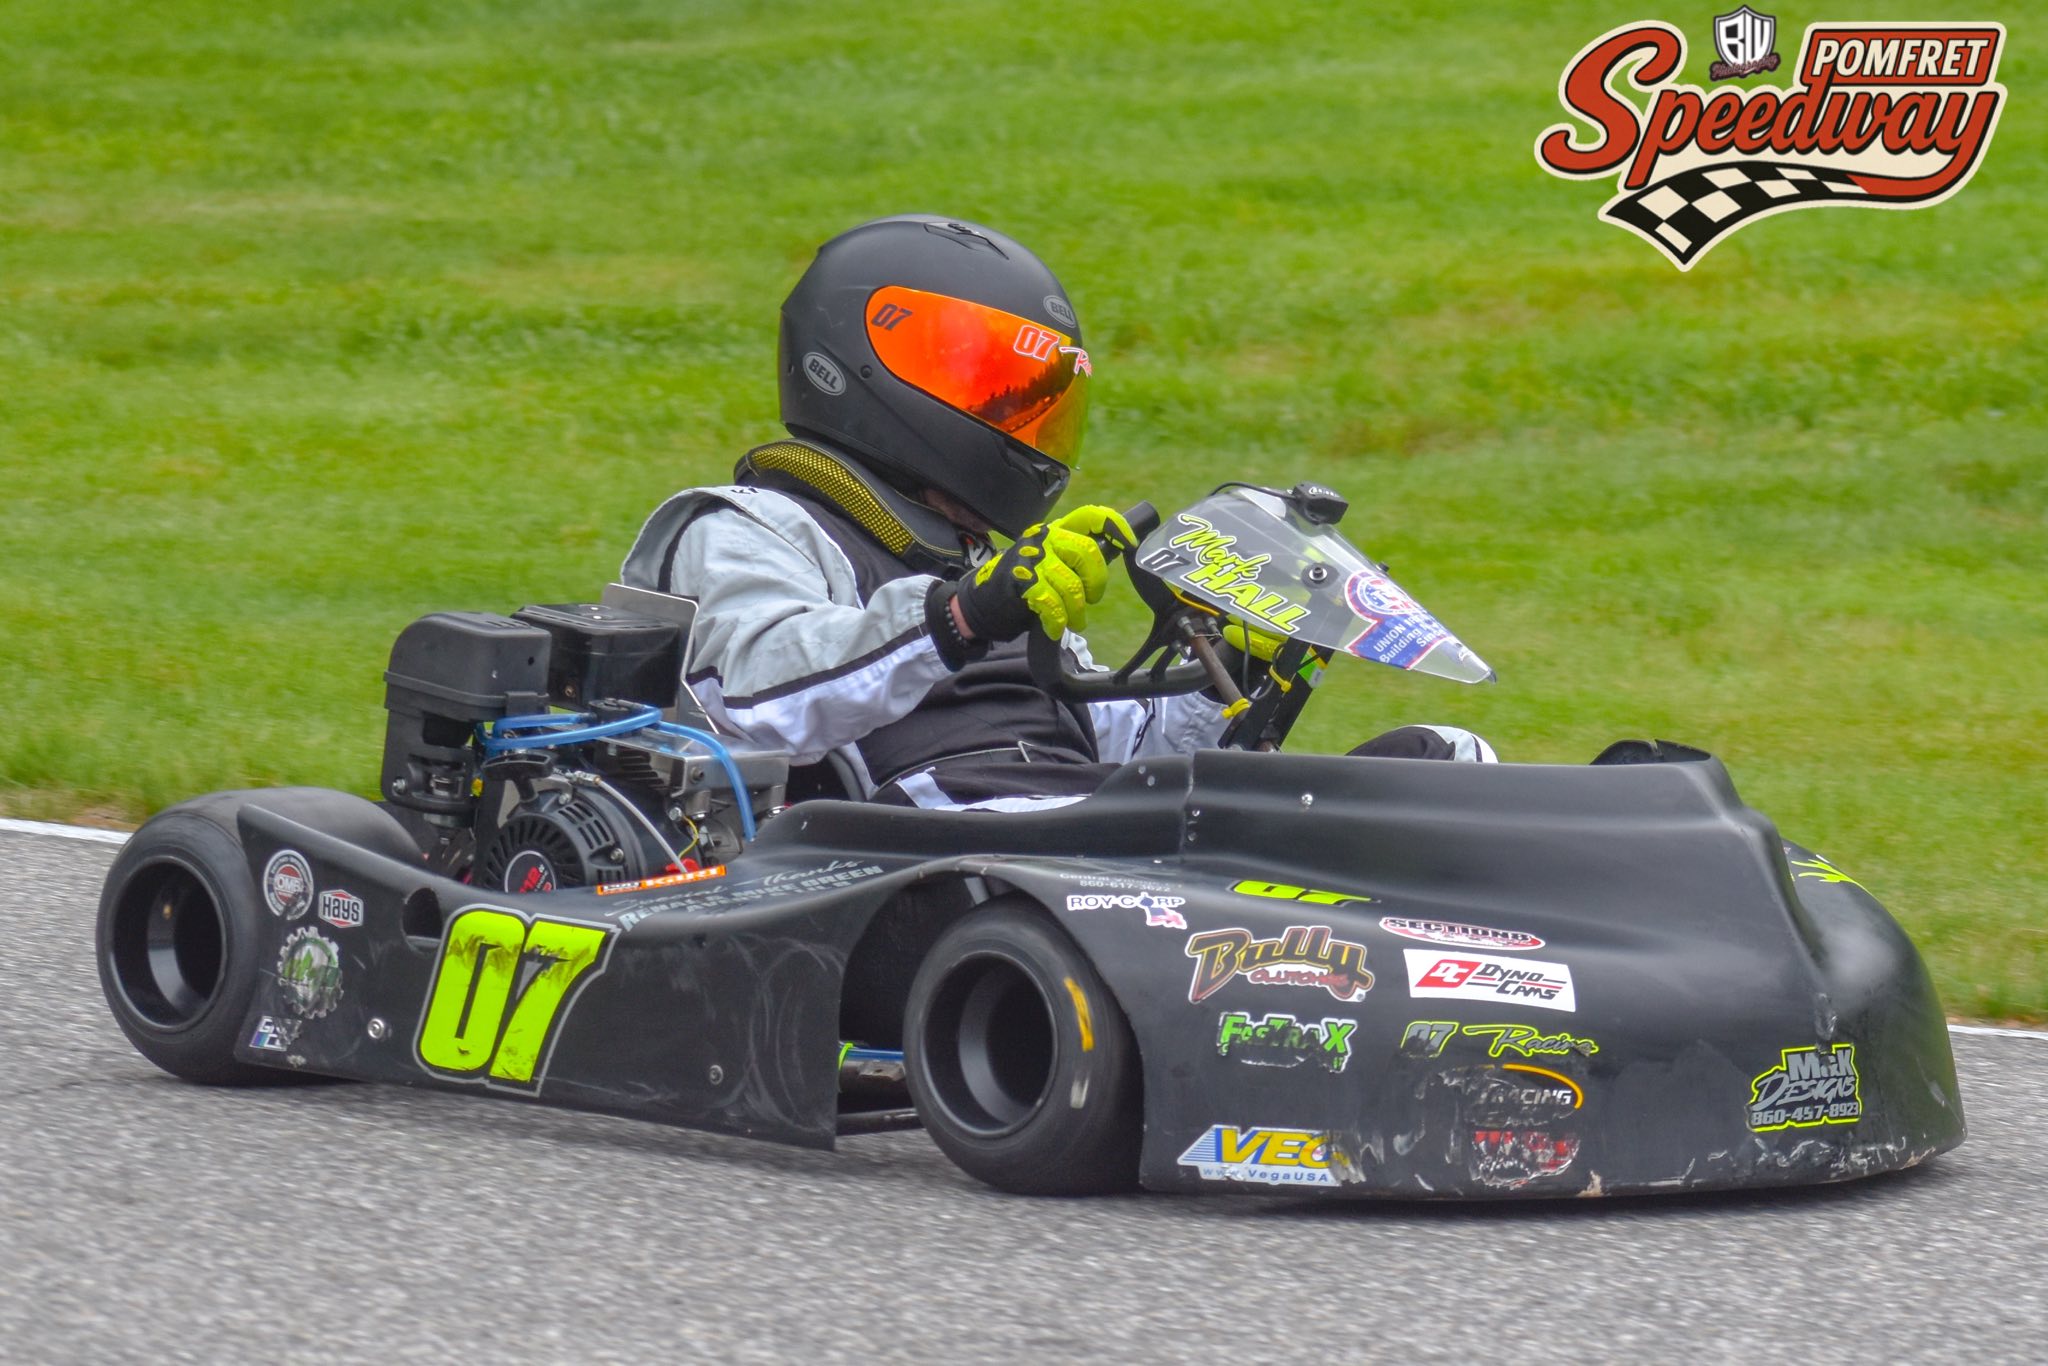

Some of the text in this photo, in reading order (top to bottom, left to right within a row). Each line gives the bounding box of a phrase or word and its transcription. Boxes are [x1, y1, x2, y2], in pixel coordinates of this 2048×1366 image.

[871, 304, 913, 331] 07
[1050, 301, 1074, 322] BELL
[1013, 324, 1061, 362] 07
[808, 358, 838, 390] BELL
[1171, 514, 1271, 579] Mark
[1183, 563, 1310, 634] HALL
[1373, 623, 1407, 652] UNION
[1189, 928, 1374, 1004] Bully
[420, 910, 606, 1083] 07
[1751, 1102, 1858, 1126] 860-457-8923
